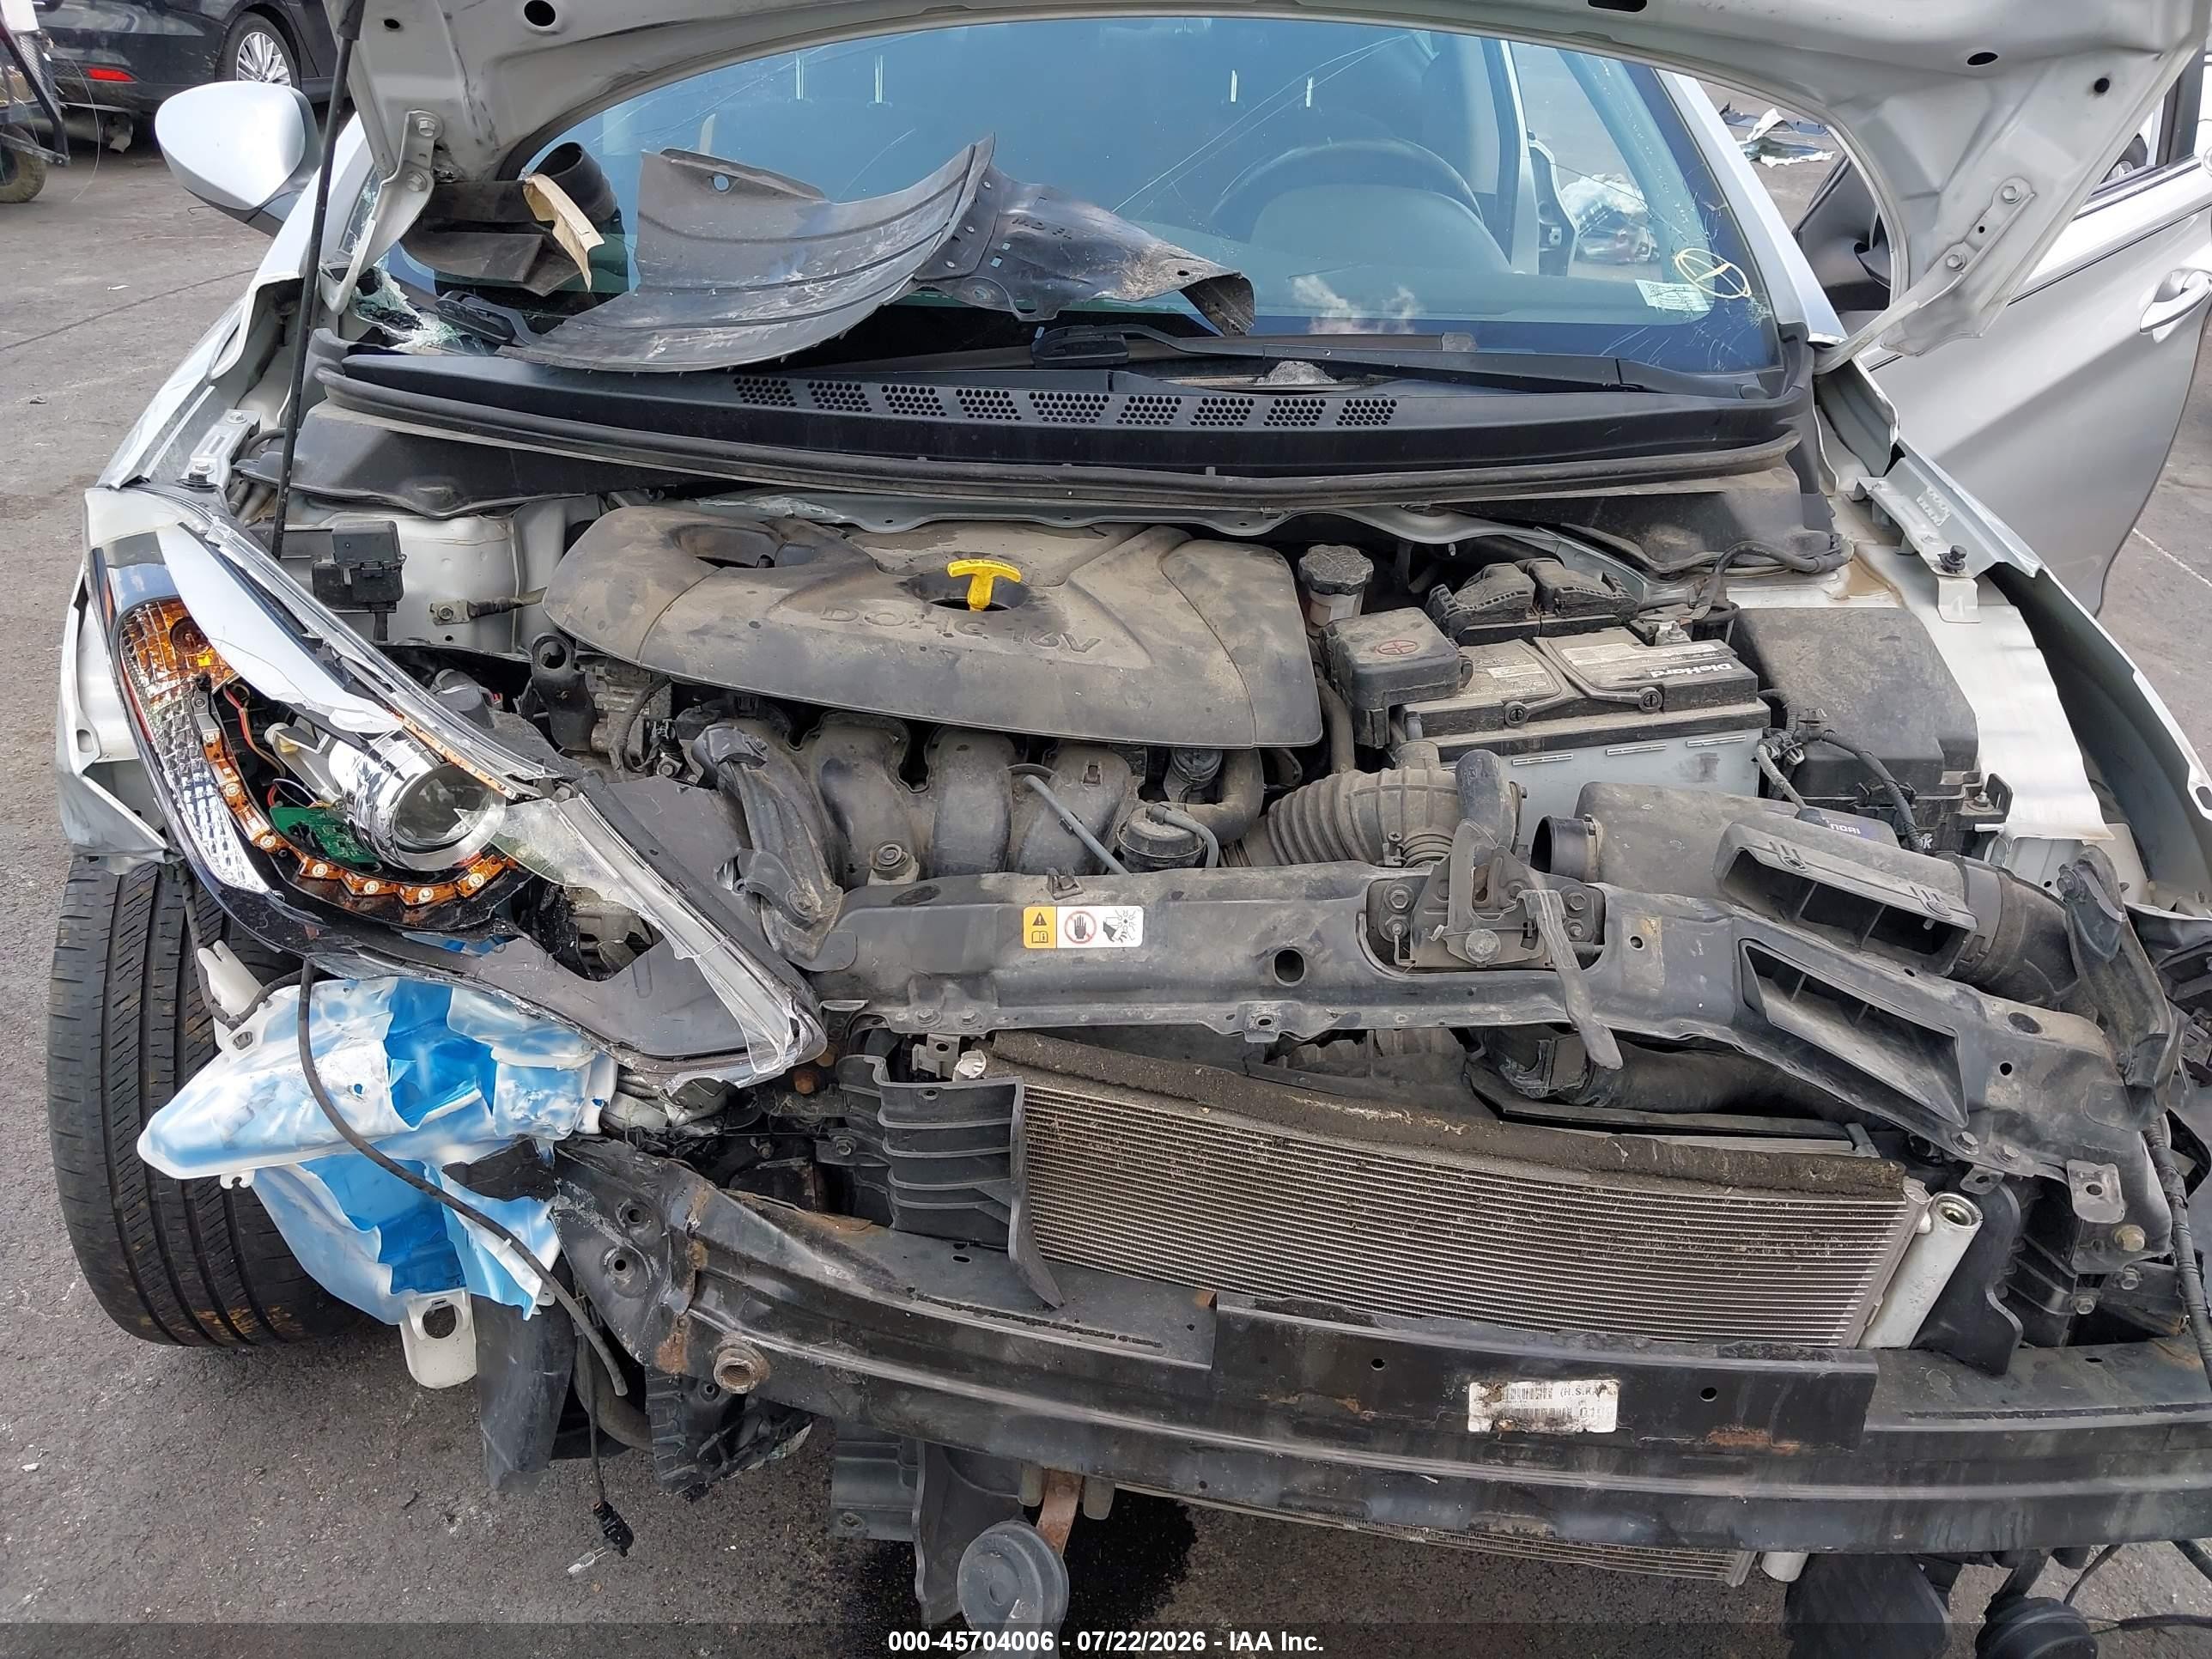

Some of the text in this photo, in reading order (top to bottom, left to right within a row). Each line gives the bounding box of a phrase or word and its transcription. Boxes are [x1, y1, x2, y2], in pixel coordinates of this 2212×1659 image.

[819, 605, 1102, 654] DOHC 16V
[1650, 663, 1733, 678] DieHard
